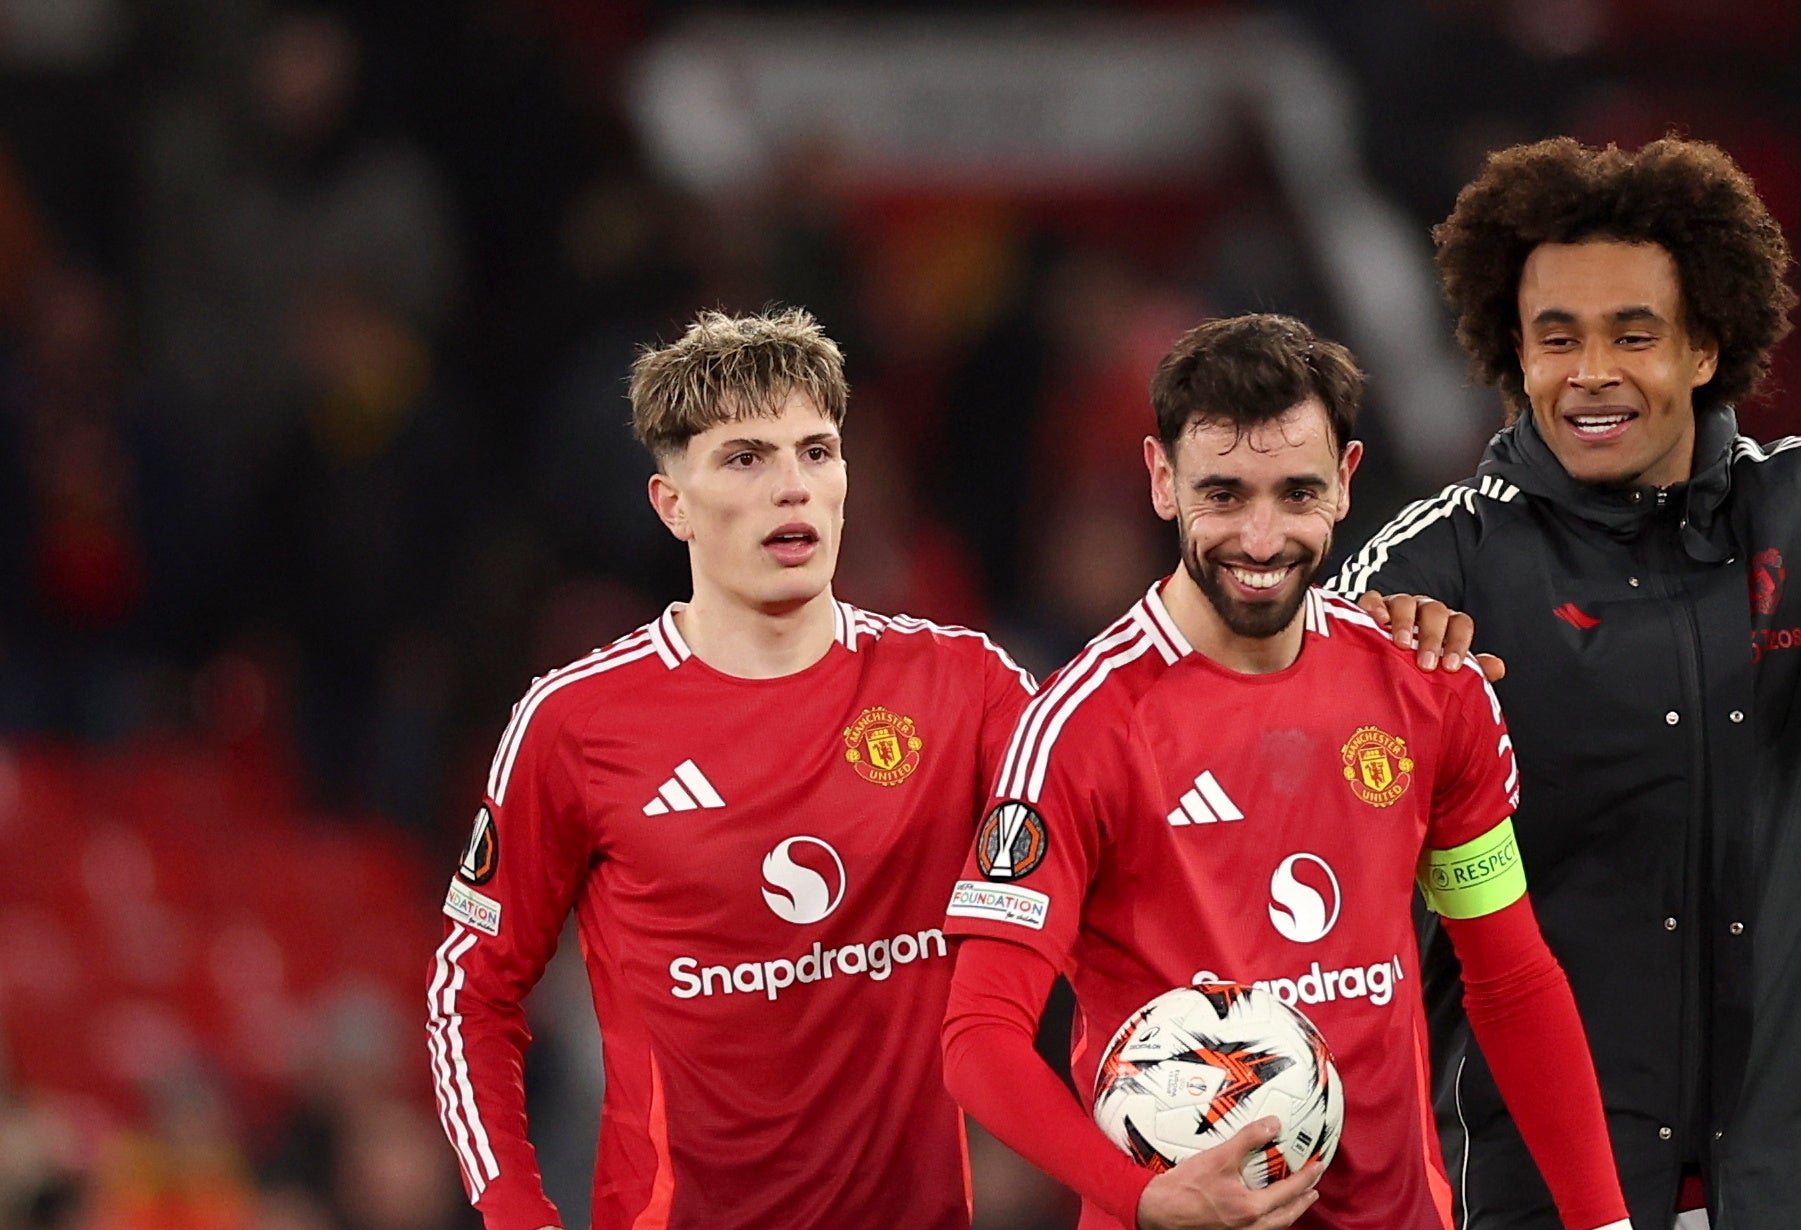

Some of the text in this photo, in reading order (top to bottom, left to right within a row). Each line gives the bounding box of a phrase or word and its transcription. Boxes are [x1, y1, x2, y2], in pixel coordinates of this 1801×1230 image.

[869, 763, 912, 780] UNITED
[1362, 784, 1402, 802] UNITED
[1453, 840, 1516, 884] RESPECT
[954, 891, 1043, 917] FOUNDATION
[669, 928, 948, 1001] Snapdragon
